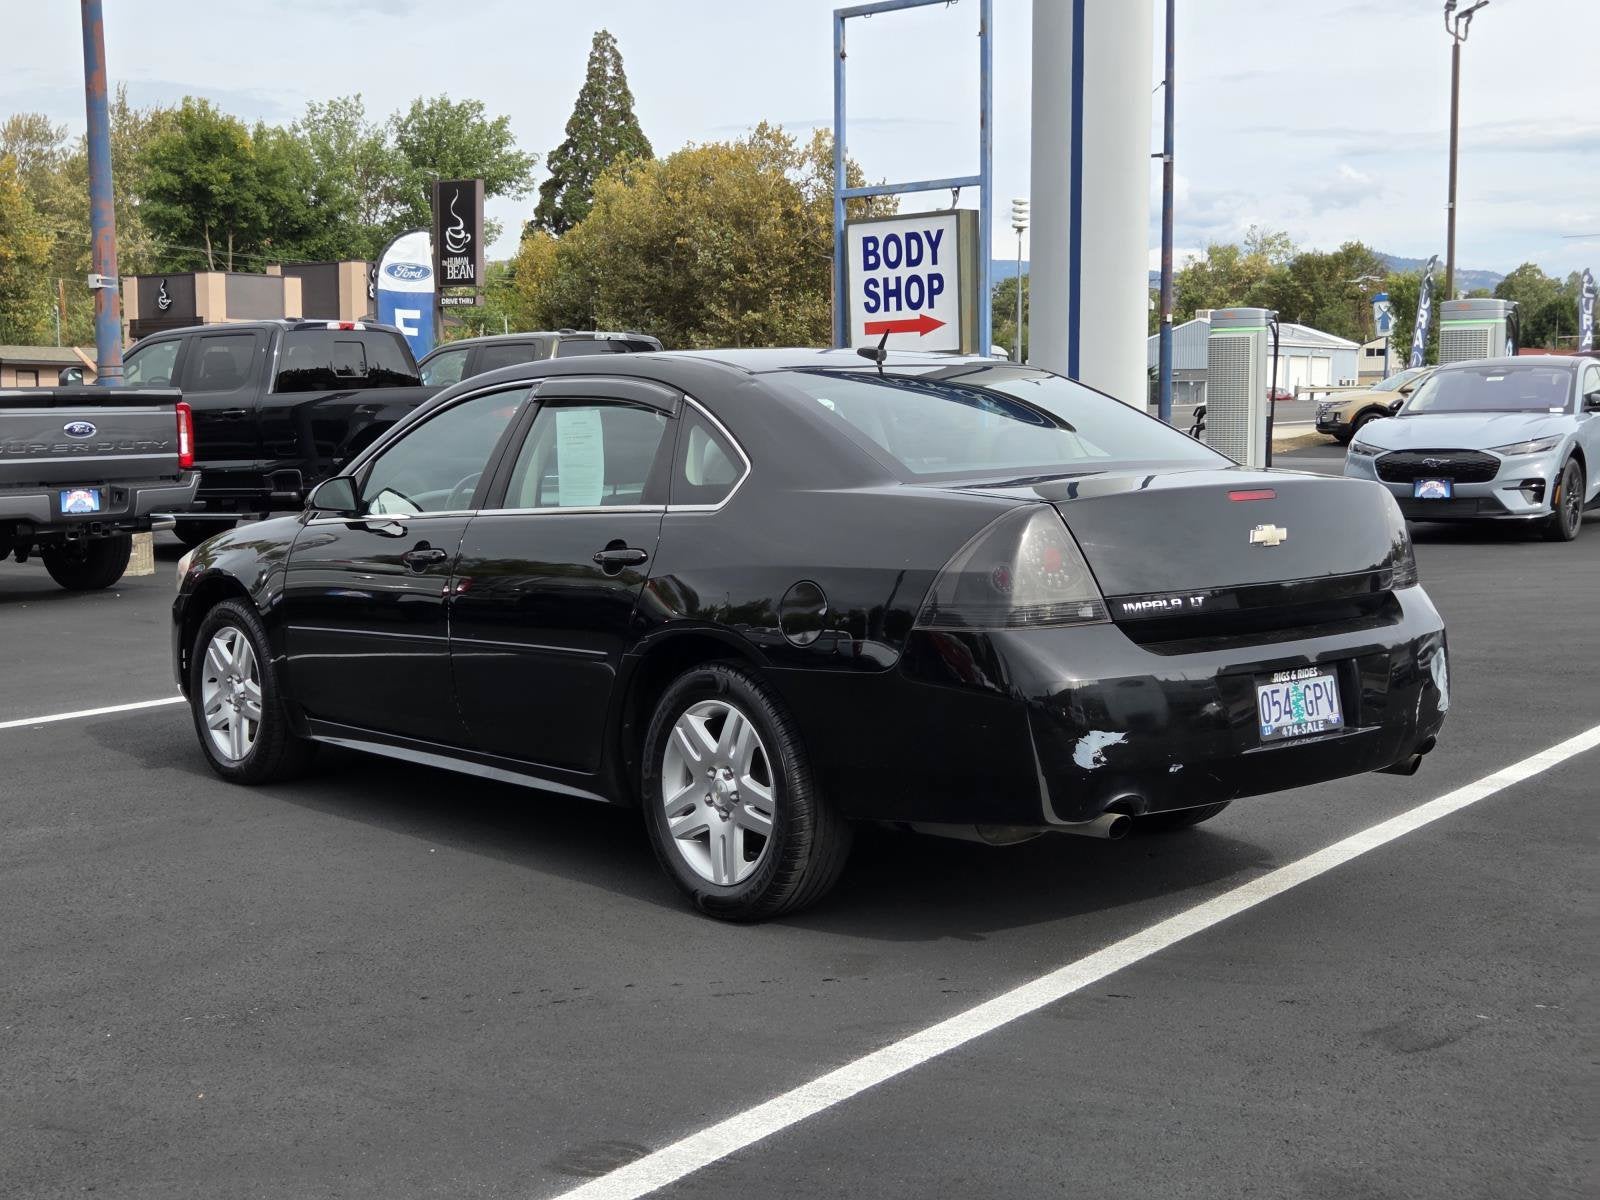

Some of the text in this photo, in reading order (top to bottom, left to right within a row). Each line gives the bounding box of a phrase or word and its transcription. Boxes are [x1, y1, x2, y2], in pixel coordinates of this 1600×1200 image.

[862, 228, 945, 272] BODY
[447, 256, 469, 266] HUMAN
[447, 264, 474, 279] BEAN
[441, 297, 474, 305] DRIVE THRU
[863, 272, 945, 314] SHOP
[0, 439, 169, 455] UPER DUTY
[1122, 596, 1205, 614] IMPALA LT
[1273, 667, 1318, 682] RIGS & RIDES
[1261, 681, 1334, 724] 054 GPV
[1281, 720, 1325, 737] 474-SALE
